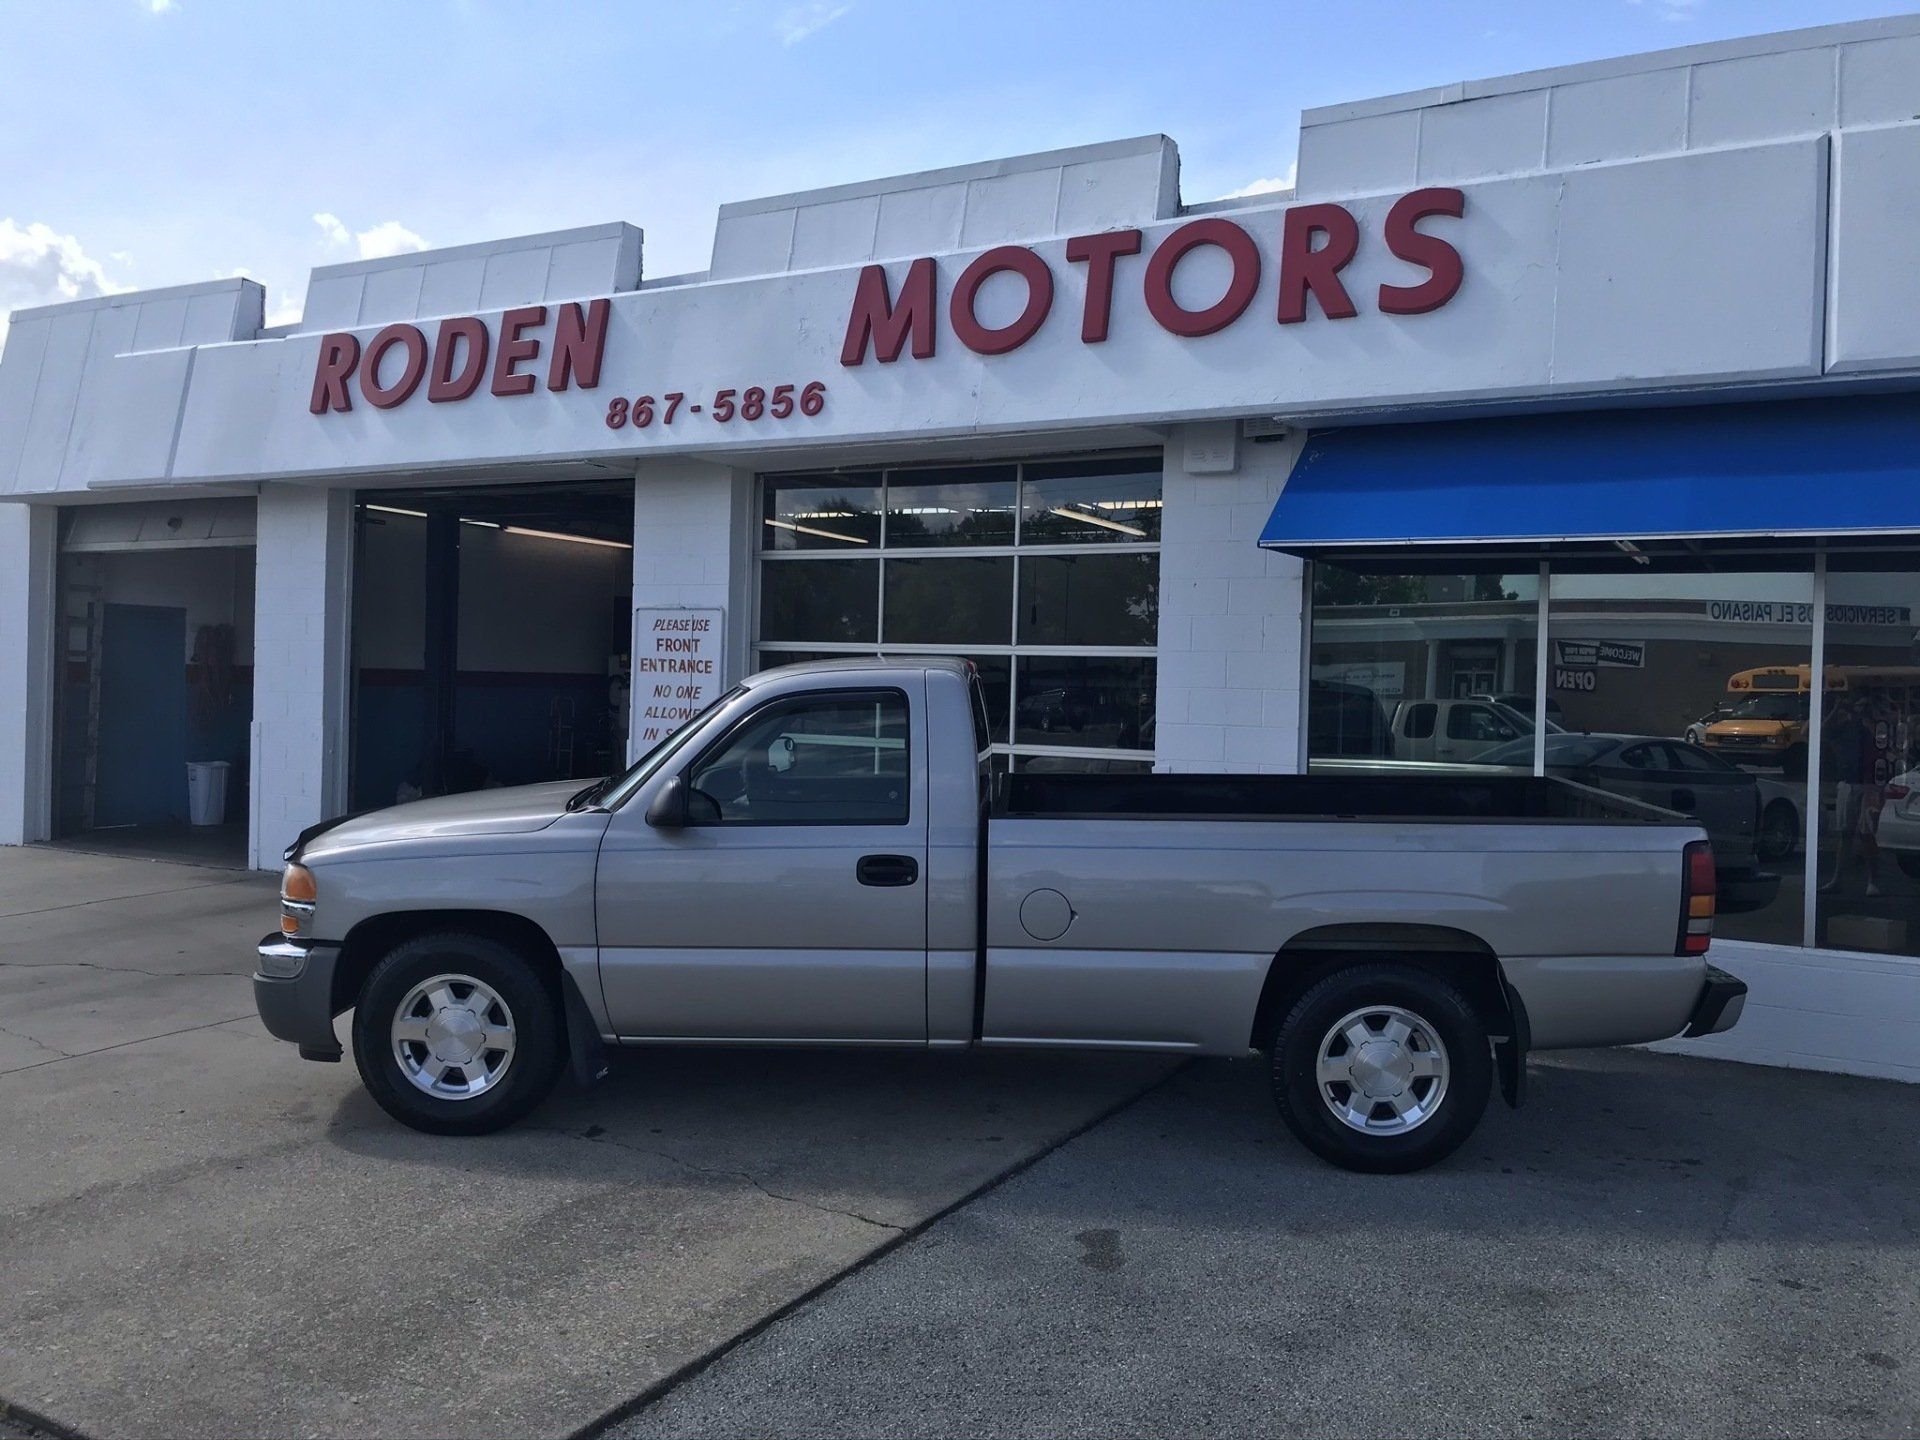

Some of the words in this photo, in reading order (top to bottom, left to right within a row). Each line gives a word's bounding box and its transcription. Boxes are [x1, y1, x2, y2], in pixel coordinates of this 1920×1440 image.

[310, 298, 611, 415] RODEN
[840, 187, 1466, 366] MOTORS
[606, 381, 826, 430] 867-5856
[653, 619, 690, 631] PLEASE
[691, 619, 710, 632] USE
[656, 638, 701, 653] FRONT
[640, 658, 713, 674] ENTRANCE
[653, 685, 671, 698] NO
[676, 685, 702, 699] ONE
[644, 706, 702, 720] ALLOWE
[643, 728, 659, 741] IN
